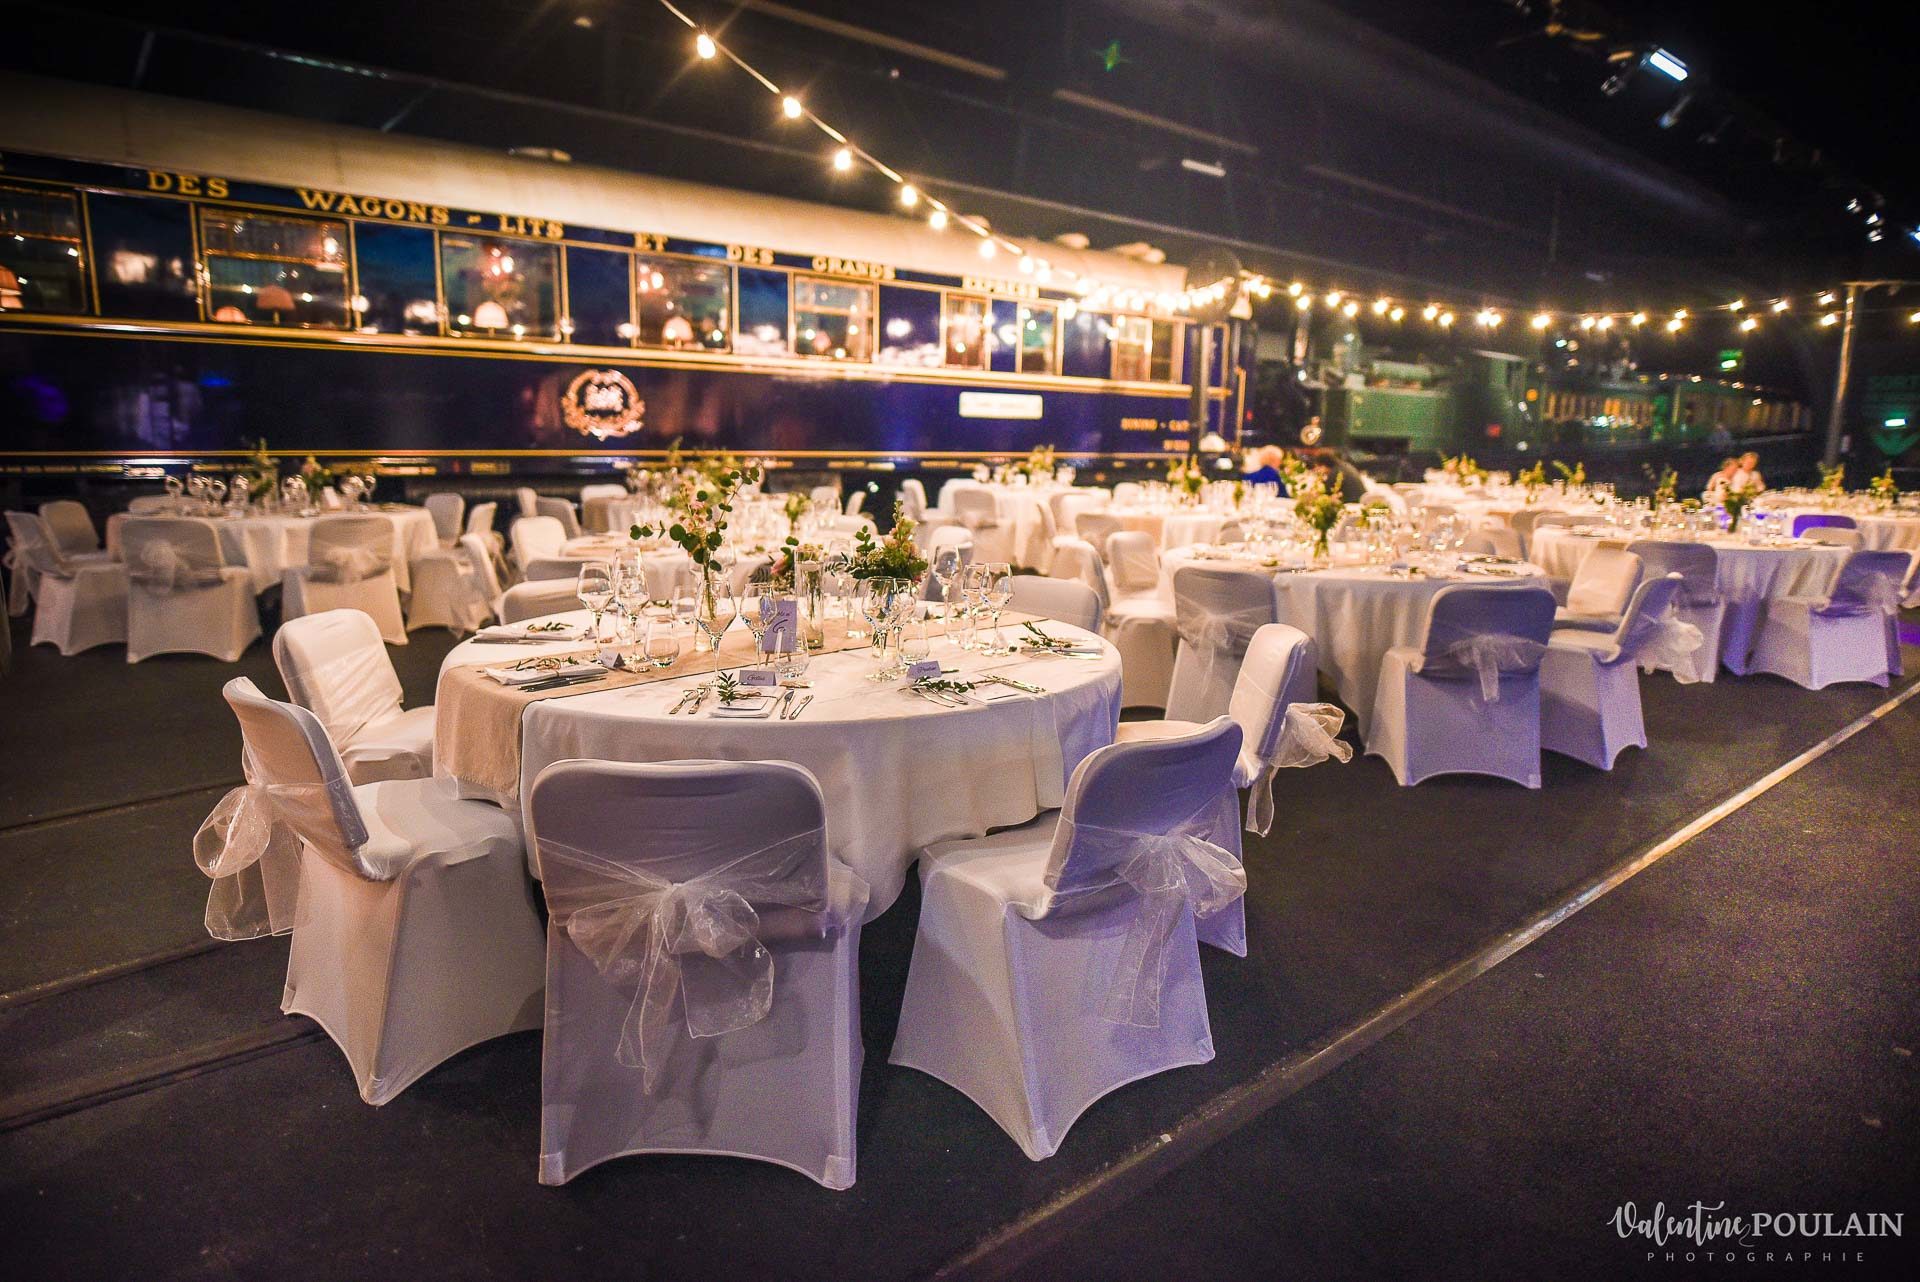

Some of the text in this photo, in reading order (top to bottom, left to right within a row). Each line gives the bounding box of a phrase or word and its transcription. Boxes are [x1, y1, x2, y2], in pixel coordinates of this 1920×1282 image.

[148, 171, 229, 198] DES
[301, 189, 449, 225] WAGONS
[500, 215, 564, 239] LITS
[634, 232, 668, 252] ET
[727, 245, 775, 265] DES
[812, 255, 896, 280] GRANDS
